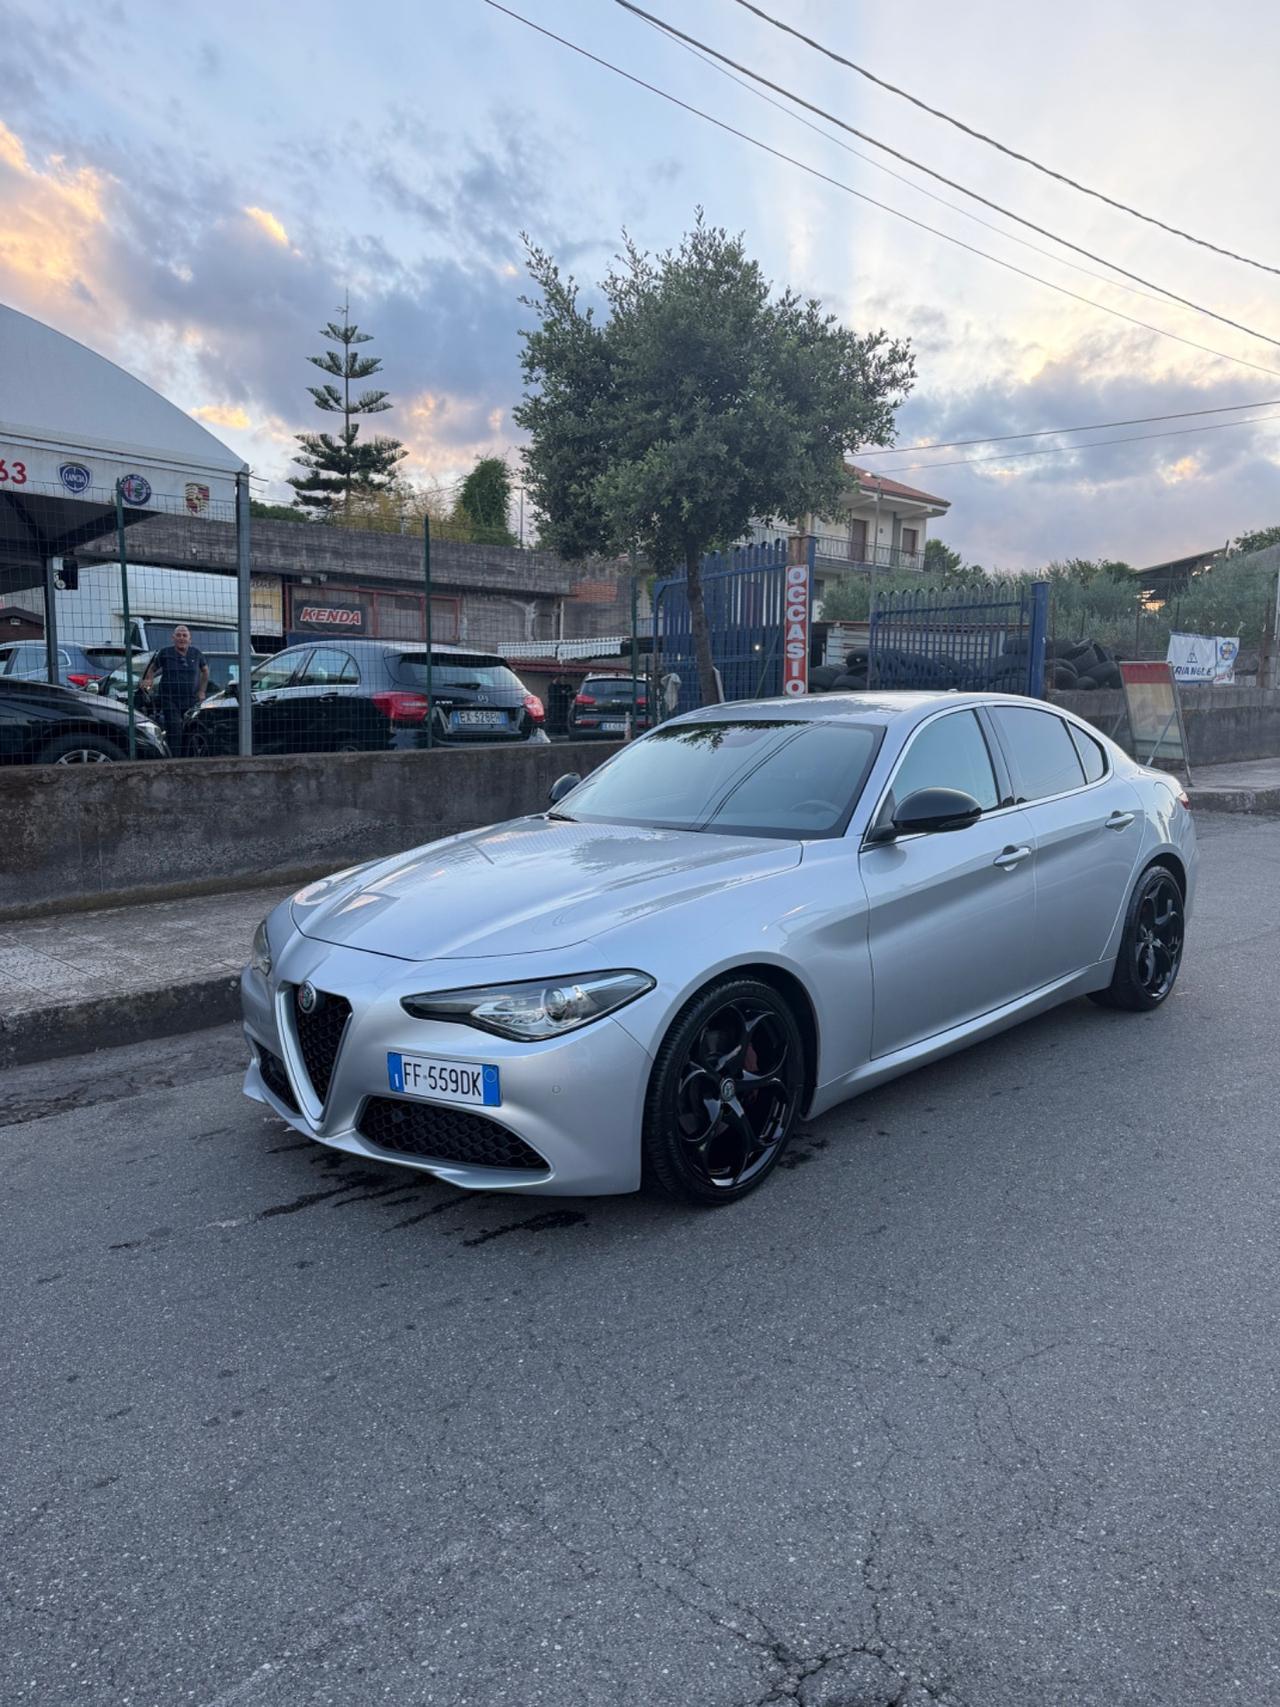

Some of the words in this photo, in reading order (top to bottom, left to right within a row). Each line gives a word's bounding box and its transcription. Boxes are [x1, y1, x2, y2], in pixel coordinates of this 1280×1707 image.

[301, 607, 361, 624] KENDA
[786, 567, 806, 697] OCCASIO
[1174, 665, 1213, 676] RIANGLE
[403, 1062, 422, 1087] FF
[428, 1066, 482, 1097] 559DK
